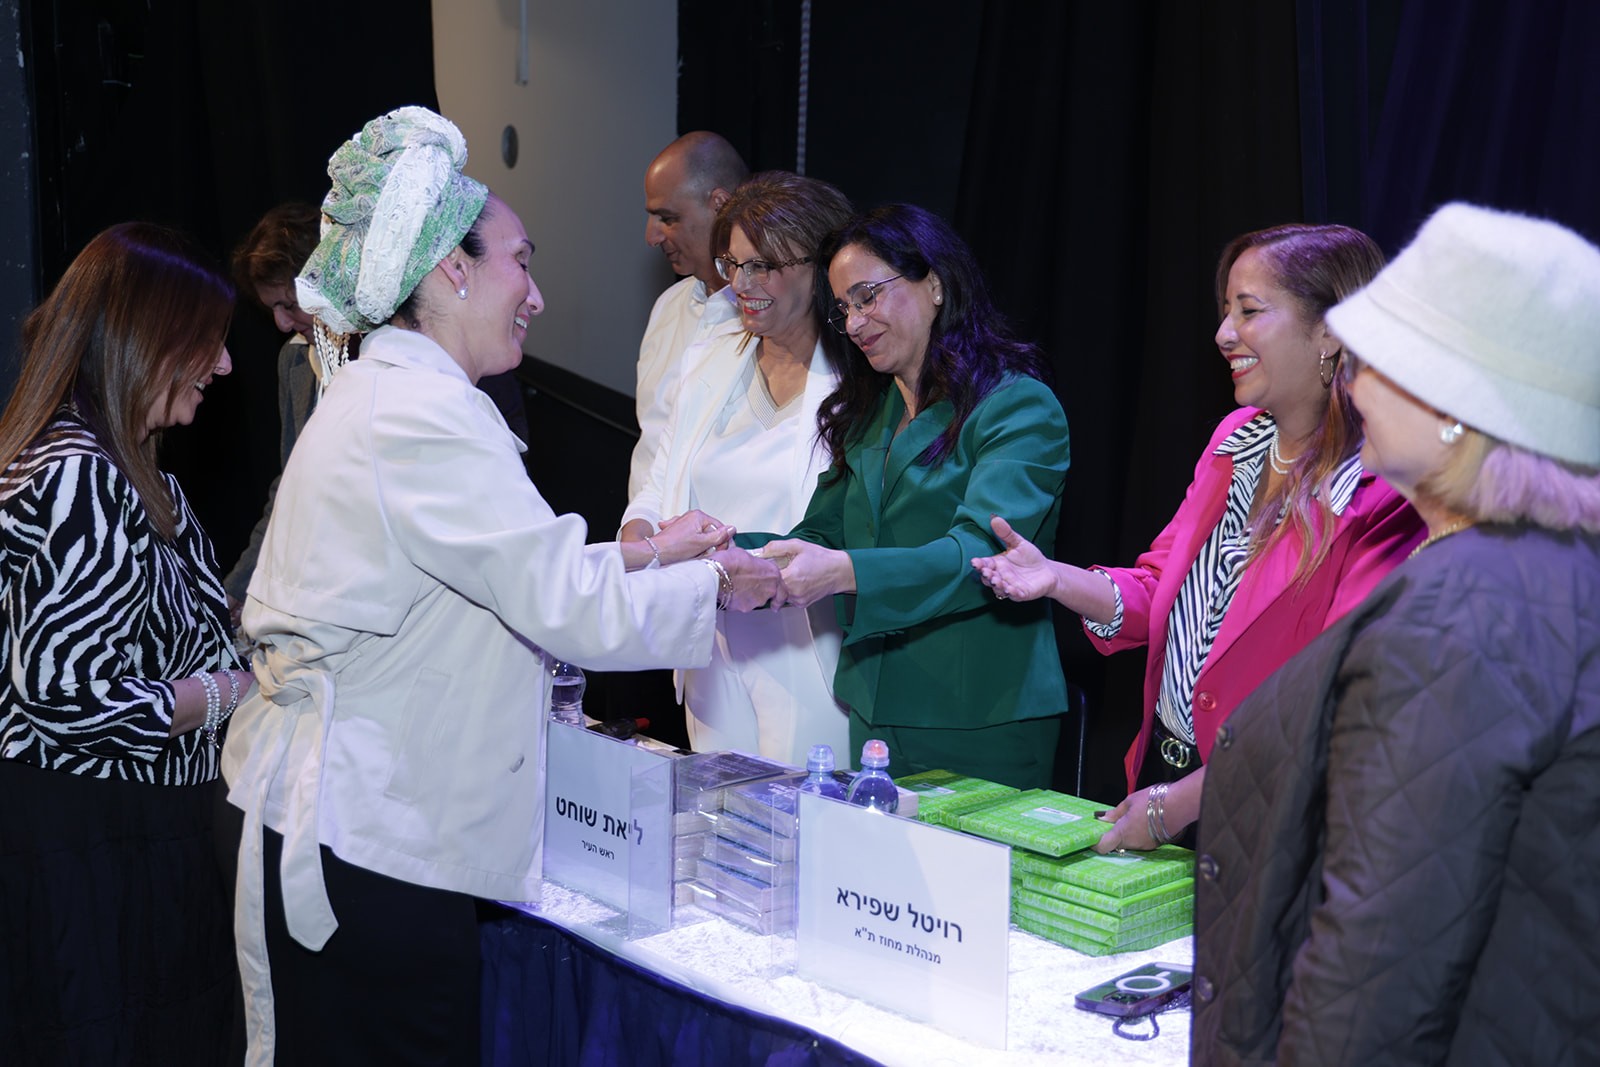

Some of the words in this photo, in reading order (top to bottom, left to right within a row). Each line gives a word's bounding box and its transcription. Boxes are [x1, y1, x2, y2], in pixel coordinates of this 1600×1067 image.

[556, 796, 597, 827] שוחט
[581, 840, 597, 853] העיר
[599, 847, 614, 860] ראש
[836, 887, 900, 921] שפירא
[907, 903, 963, 942] רויטל
[879, 934, 902, 951] מחוז
[906, 943, 941, 964] מנהלת
